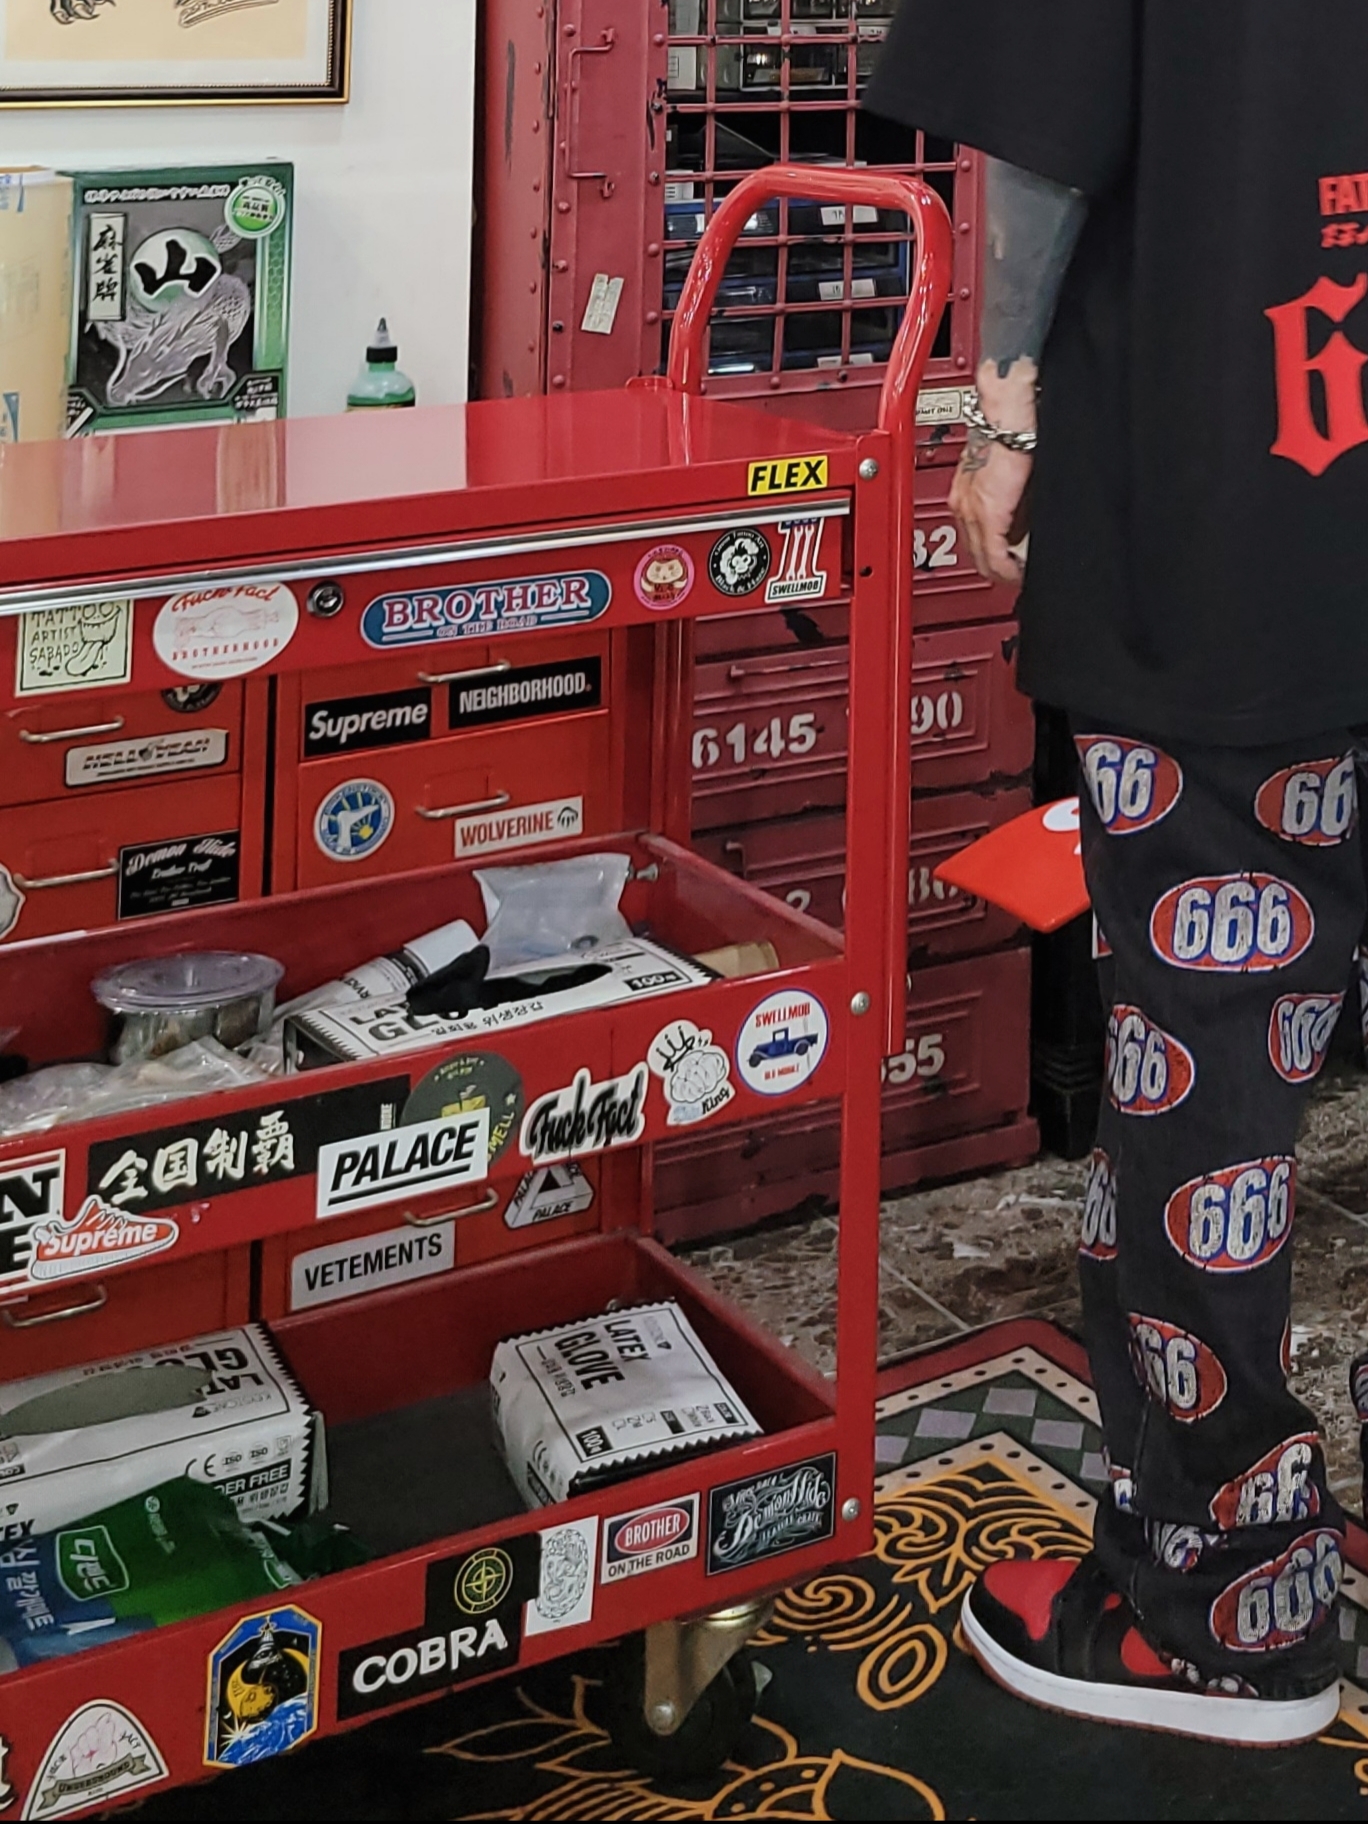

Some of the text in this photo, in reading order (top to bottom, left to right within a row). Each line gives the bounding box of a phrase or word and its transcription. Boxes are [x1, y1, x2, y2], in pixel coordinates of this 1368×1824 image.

[750, 458, 825, 492] FLEX
[383, 576, 590, 629] BROTHER
[772, 580, 819, 596] SWELLMOB
[32, 627, 78, 644] ARTIST
[462, 620, 492, 637] THE
[497, 614, 538, 632] ROAD
[30, 642, 79, 664] SABADO
[172, 638, 280, 661] BROTHERHOOD
[308, 699, 428, 746] Supreme
[692, 712, 817, 769] 6145
[82, 753, 138, 770] HELL
[460, 810, 554, 848] WOLVERINE
[1172, 879, 1293, 963] 666
[481, 1001, 544, 1026] 위생장갑
[755, 1002, 811, 1028] SWELLMOB
[529, 1074, 588, 1158] Fuck
[702, 1088, 730, 1114] King
[331, 1121, 479, 1192] PALACE
[532, 1203, 572, 1220] PALACE
[1188, 1163, 1290, 1262] 666
[44, 1223, 158, 1257] Supreme
[304, 1232, 443, 1291] VETEMENTS
[603, 1319, 652, 1363] LATEX
[553, 1331, 626, 1390] GLOVE
[251, 1446, 268, 1458] ISO
[249, 1463, 289, 1487] FREE
[625, 1513, 680, 1547] BROTHER
[608, 1544, 690, 1577] ON THE ROAD
[352, 1618, 509, 1694] COBRA
